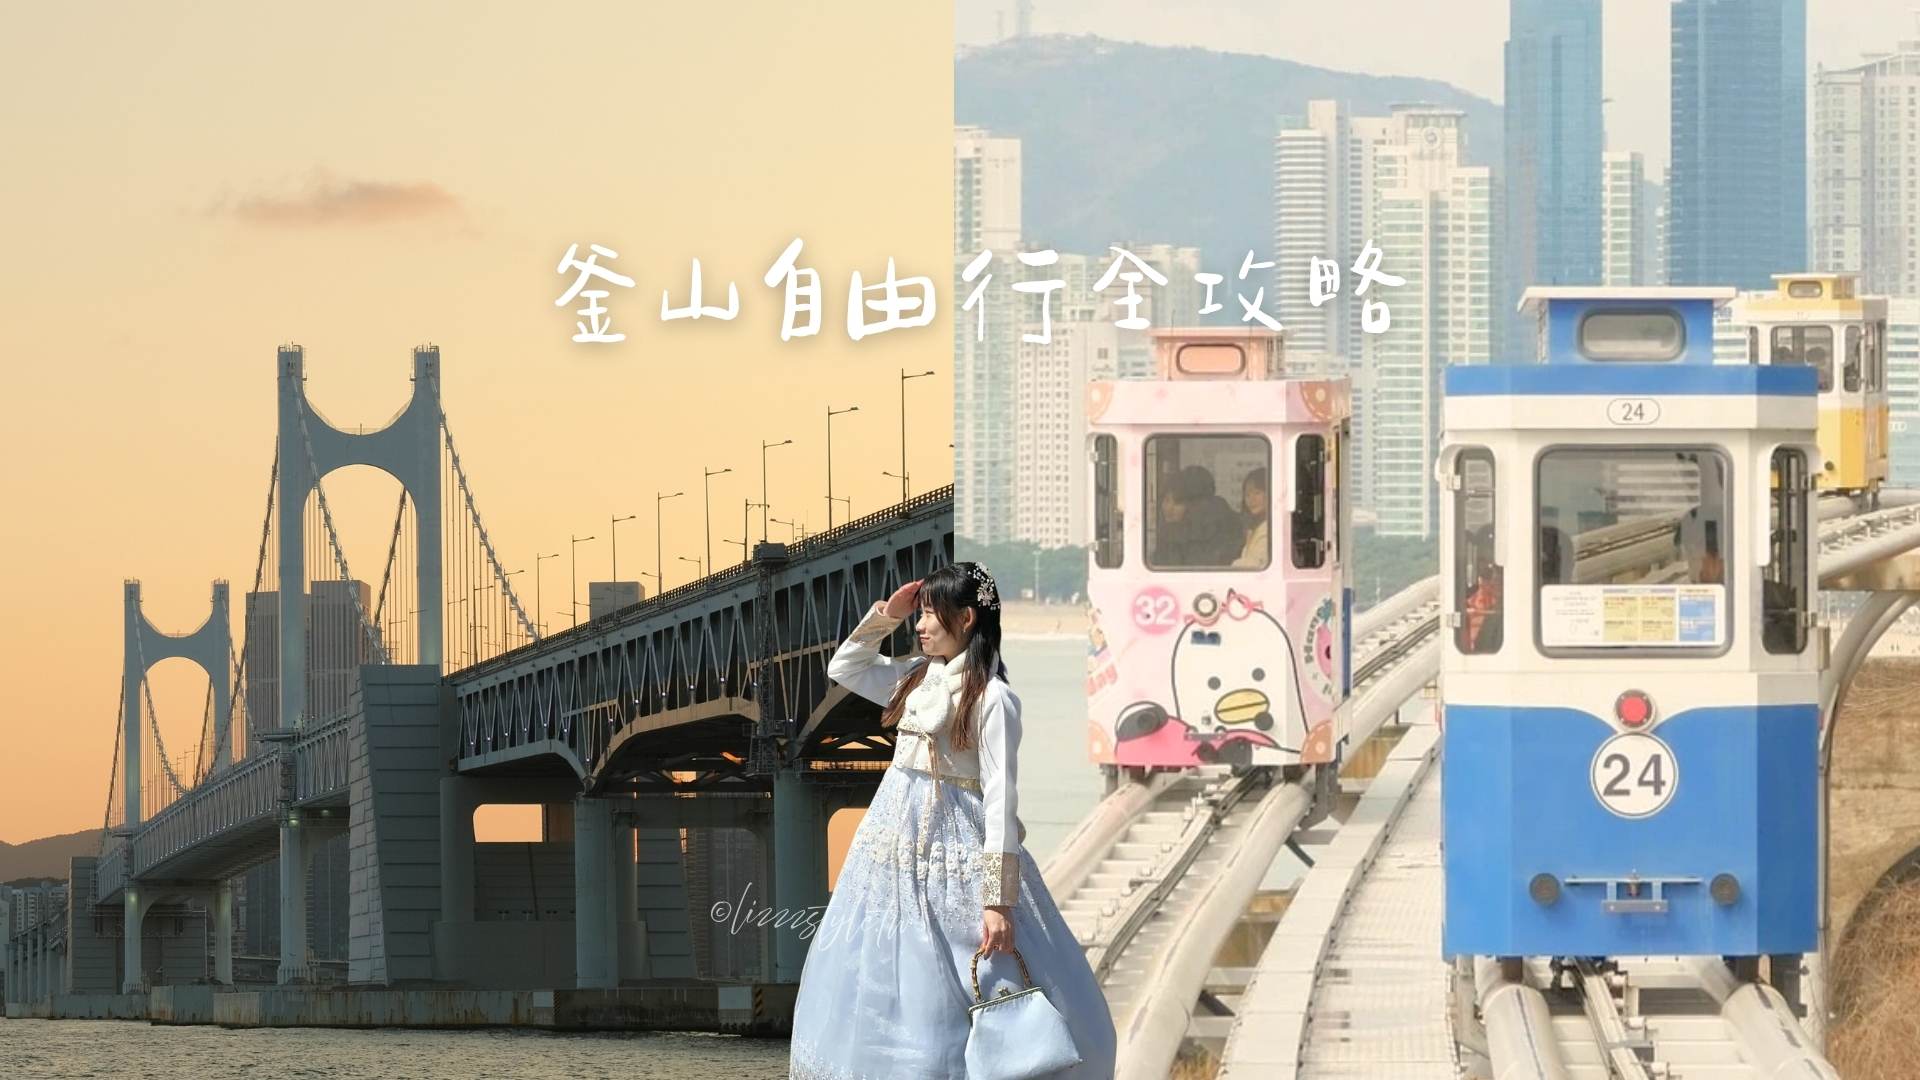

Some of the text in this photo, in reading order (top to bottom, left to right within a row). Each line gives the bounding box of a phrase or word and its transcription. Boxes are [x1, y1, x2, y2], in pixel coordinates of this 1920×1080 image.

[1621, 402, 1645, 421] 24
[1135, 593, 1178, 625] 32
[1602, 753, 1667, 797] 24
